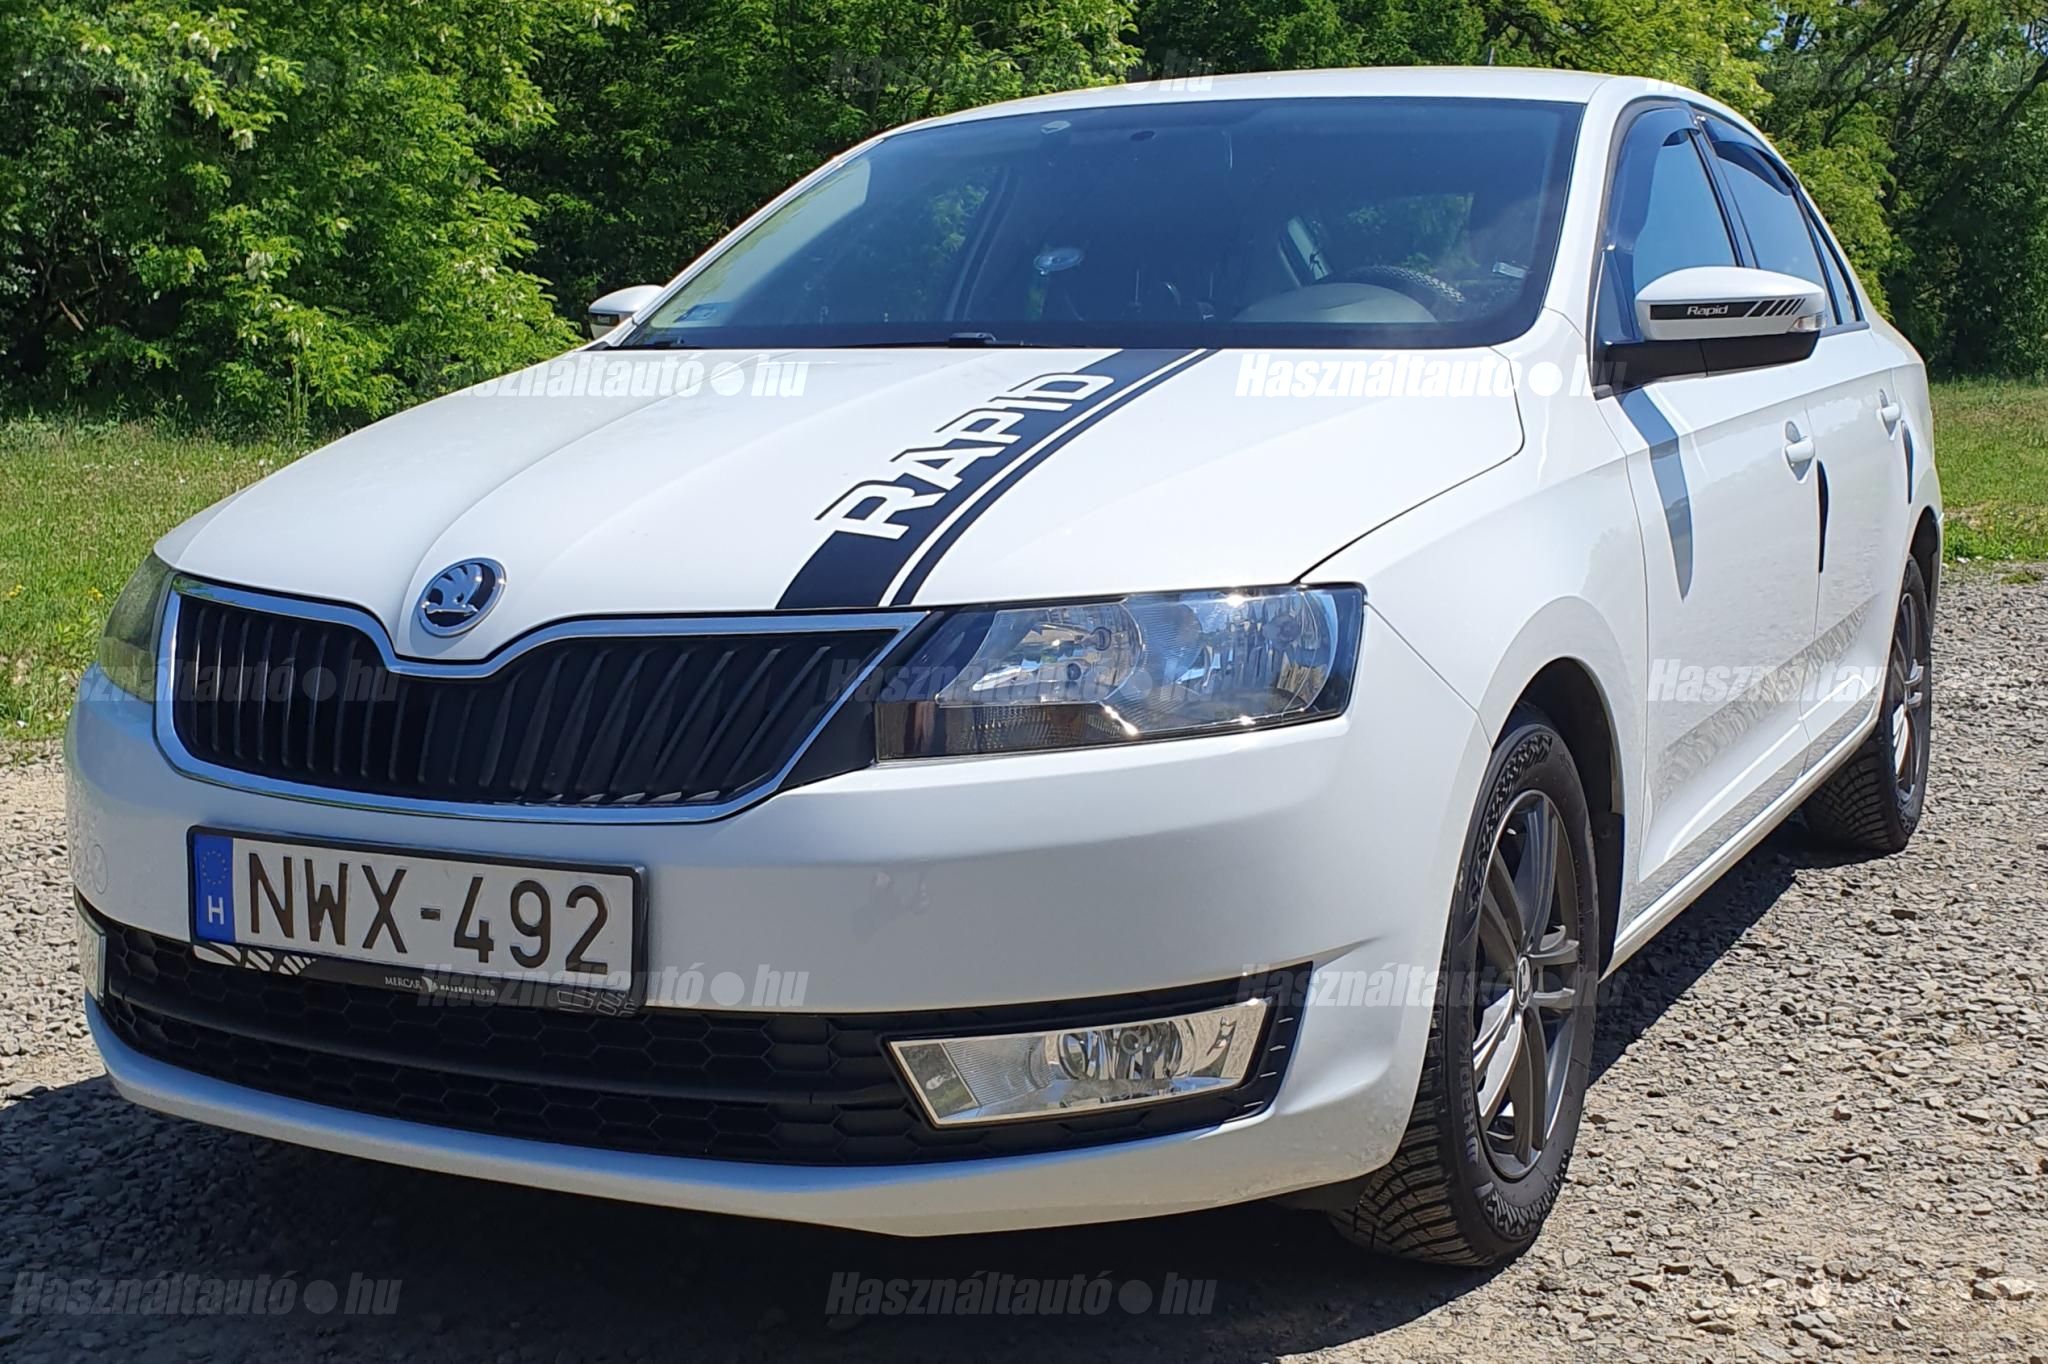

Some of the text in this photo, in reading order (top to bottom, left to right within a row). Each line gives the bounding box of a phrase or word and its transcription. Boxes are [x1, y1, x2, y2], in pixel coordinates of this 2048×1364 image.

[1687, 304, 1729, 316] Rapid
[814, 372, 1115, 540] RAPID
[207, 895, 225, 926] H
[248, 852, 609, 976] NWX-492
[384, 976, 423, 990] MERCAR
